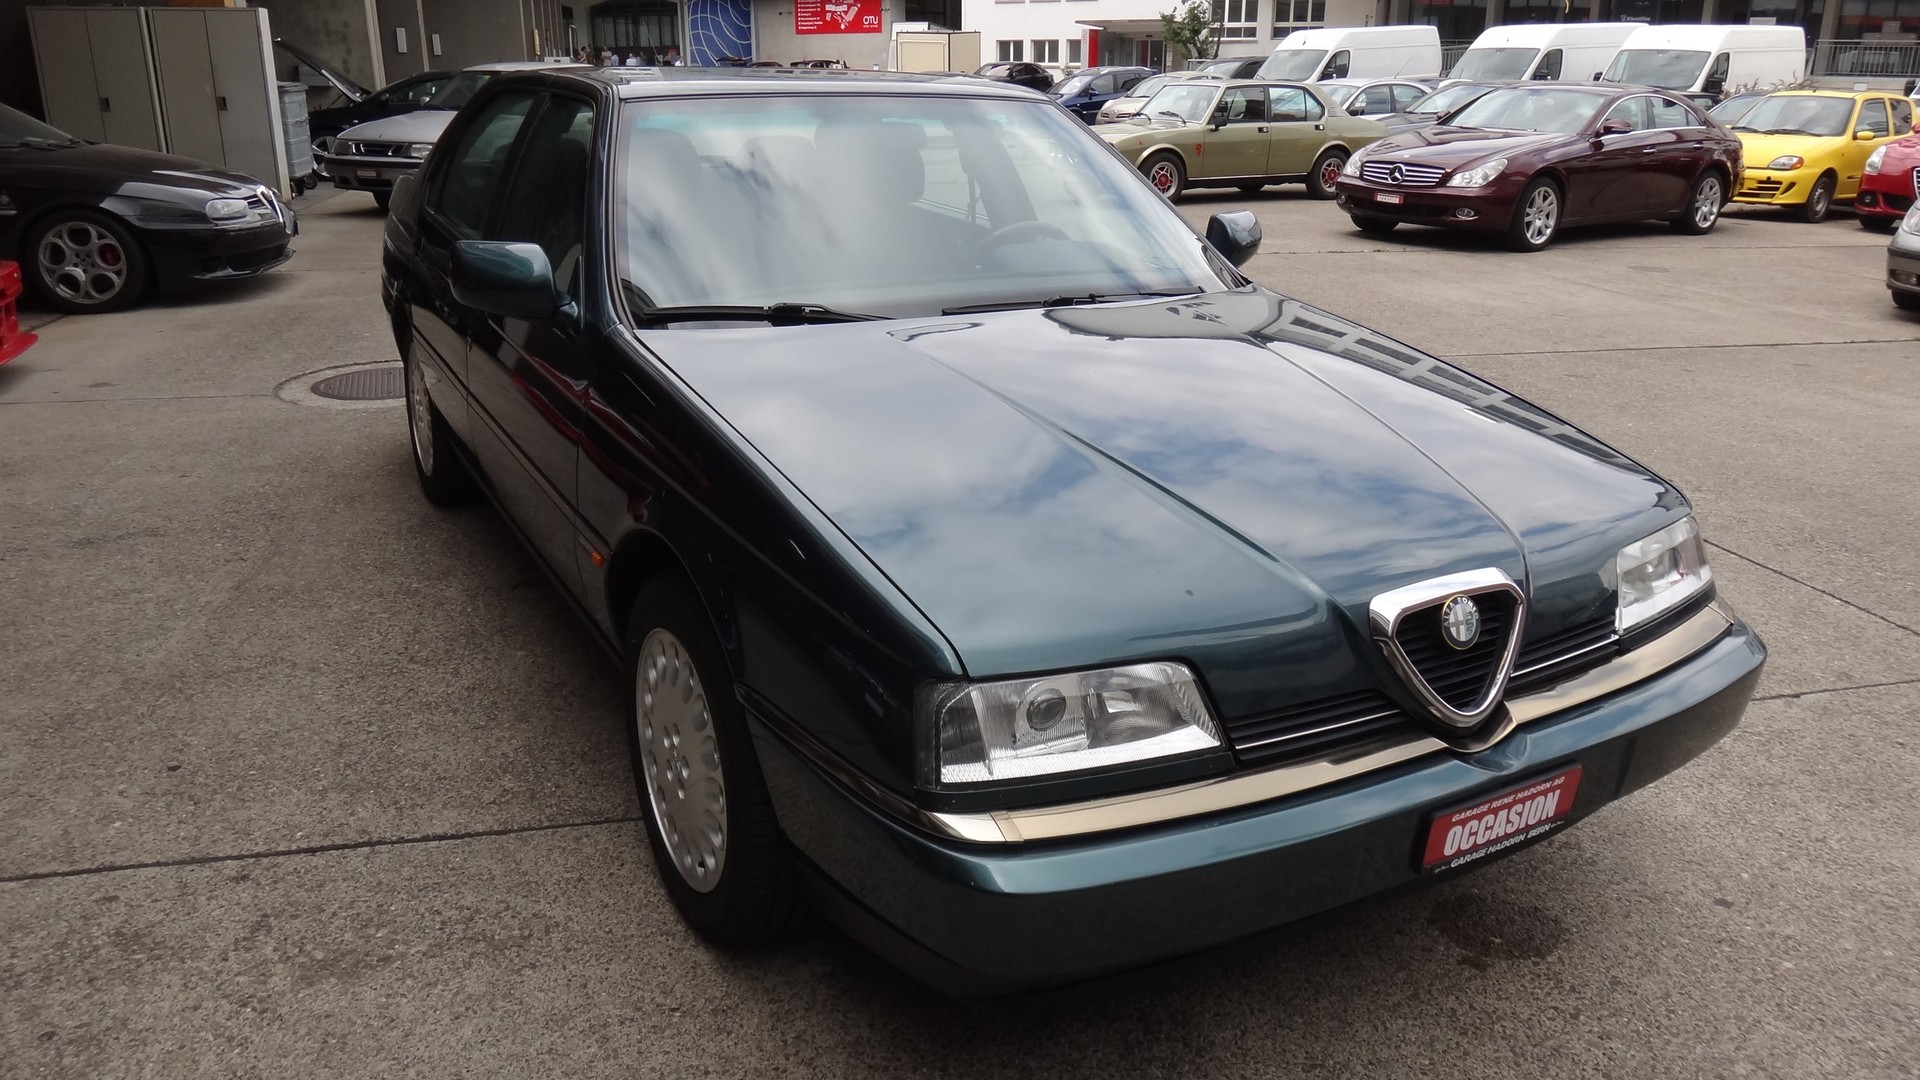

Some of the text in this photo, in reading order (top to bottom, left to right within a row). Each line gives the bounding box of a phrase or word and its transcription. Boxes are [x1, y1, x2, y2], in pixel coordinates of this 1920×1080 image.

[1452, 776, 1565, 822] GARAGE RENE HADORN AG
[1443, 789, 1561, 856] OCCASION
[1451, 823, 1551, 868] GARAGE HADORN BERN
